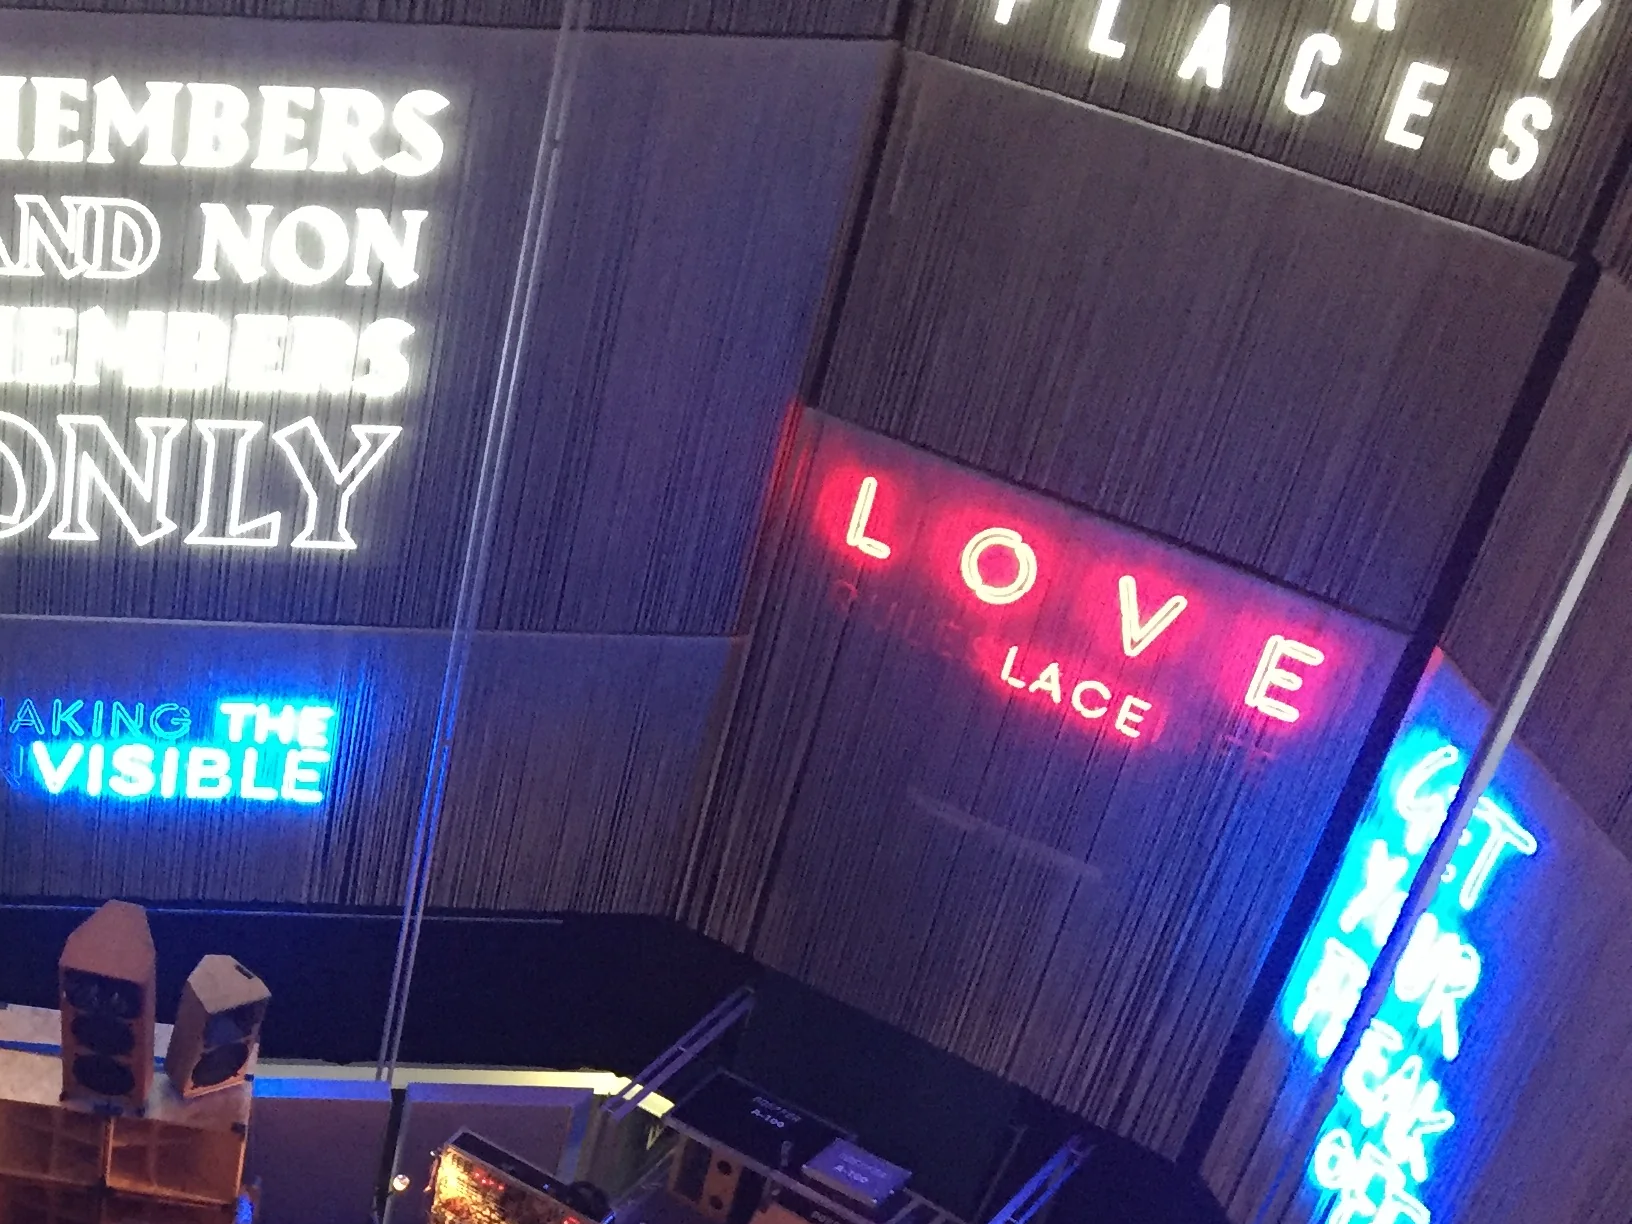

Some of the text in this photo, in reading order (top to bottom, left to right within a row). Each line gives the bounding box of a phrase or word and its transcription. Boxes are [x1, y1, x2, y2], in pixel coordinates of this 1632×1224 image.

[994, 0, 1554, 181] LACES
[192, 202, 429, 289] NON
[846, 476, 1325, 723] LOVE
[220, 701, 334, 748] THE
[1395, 745, 1538, 910] GT
